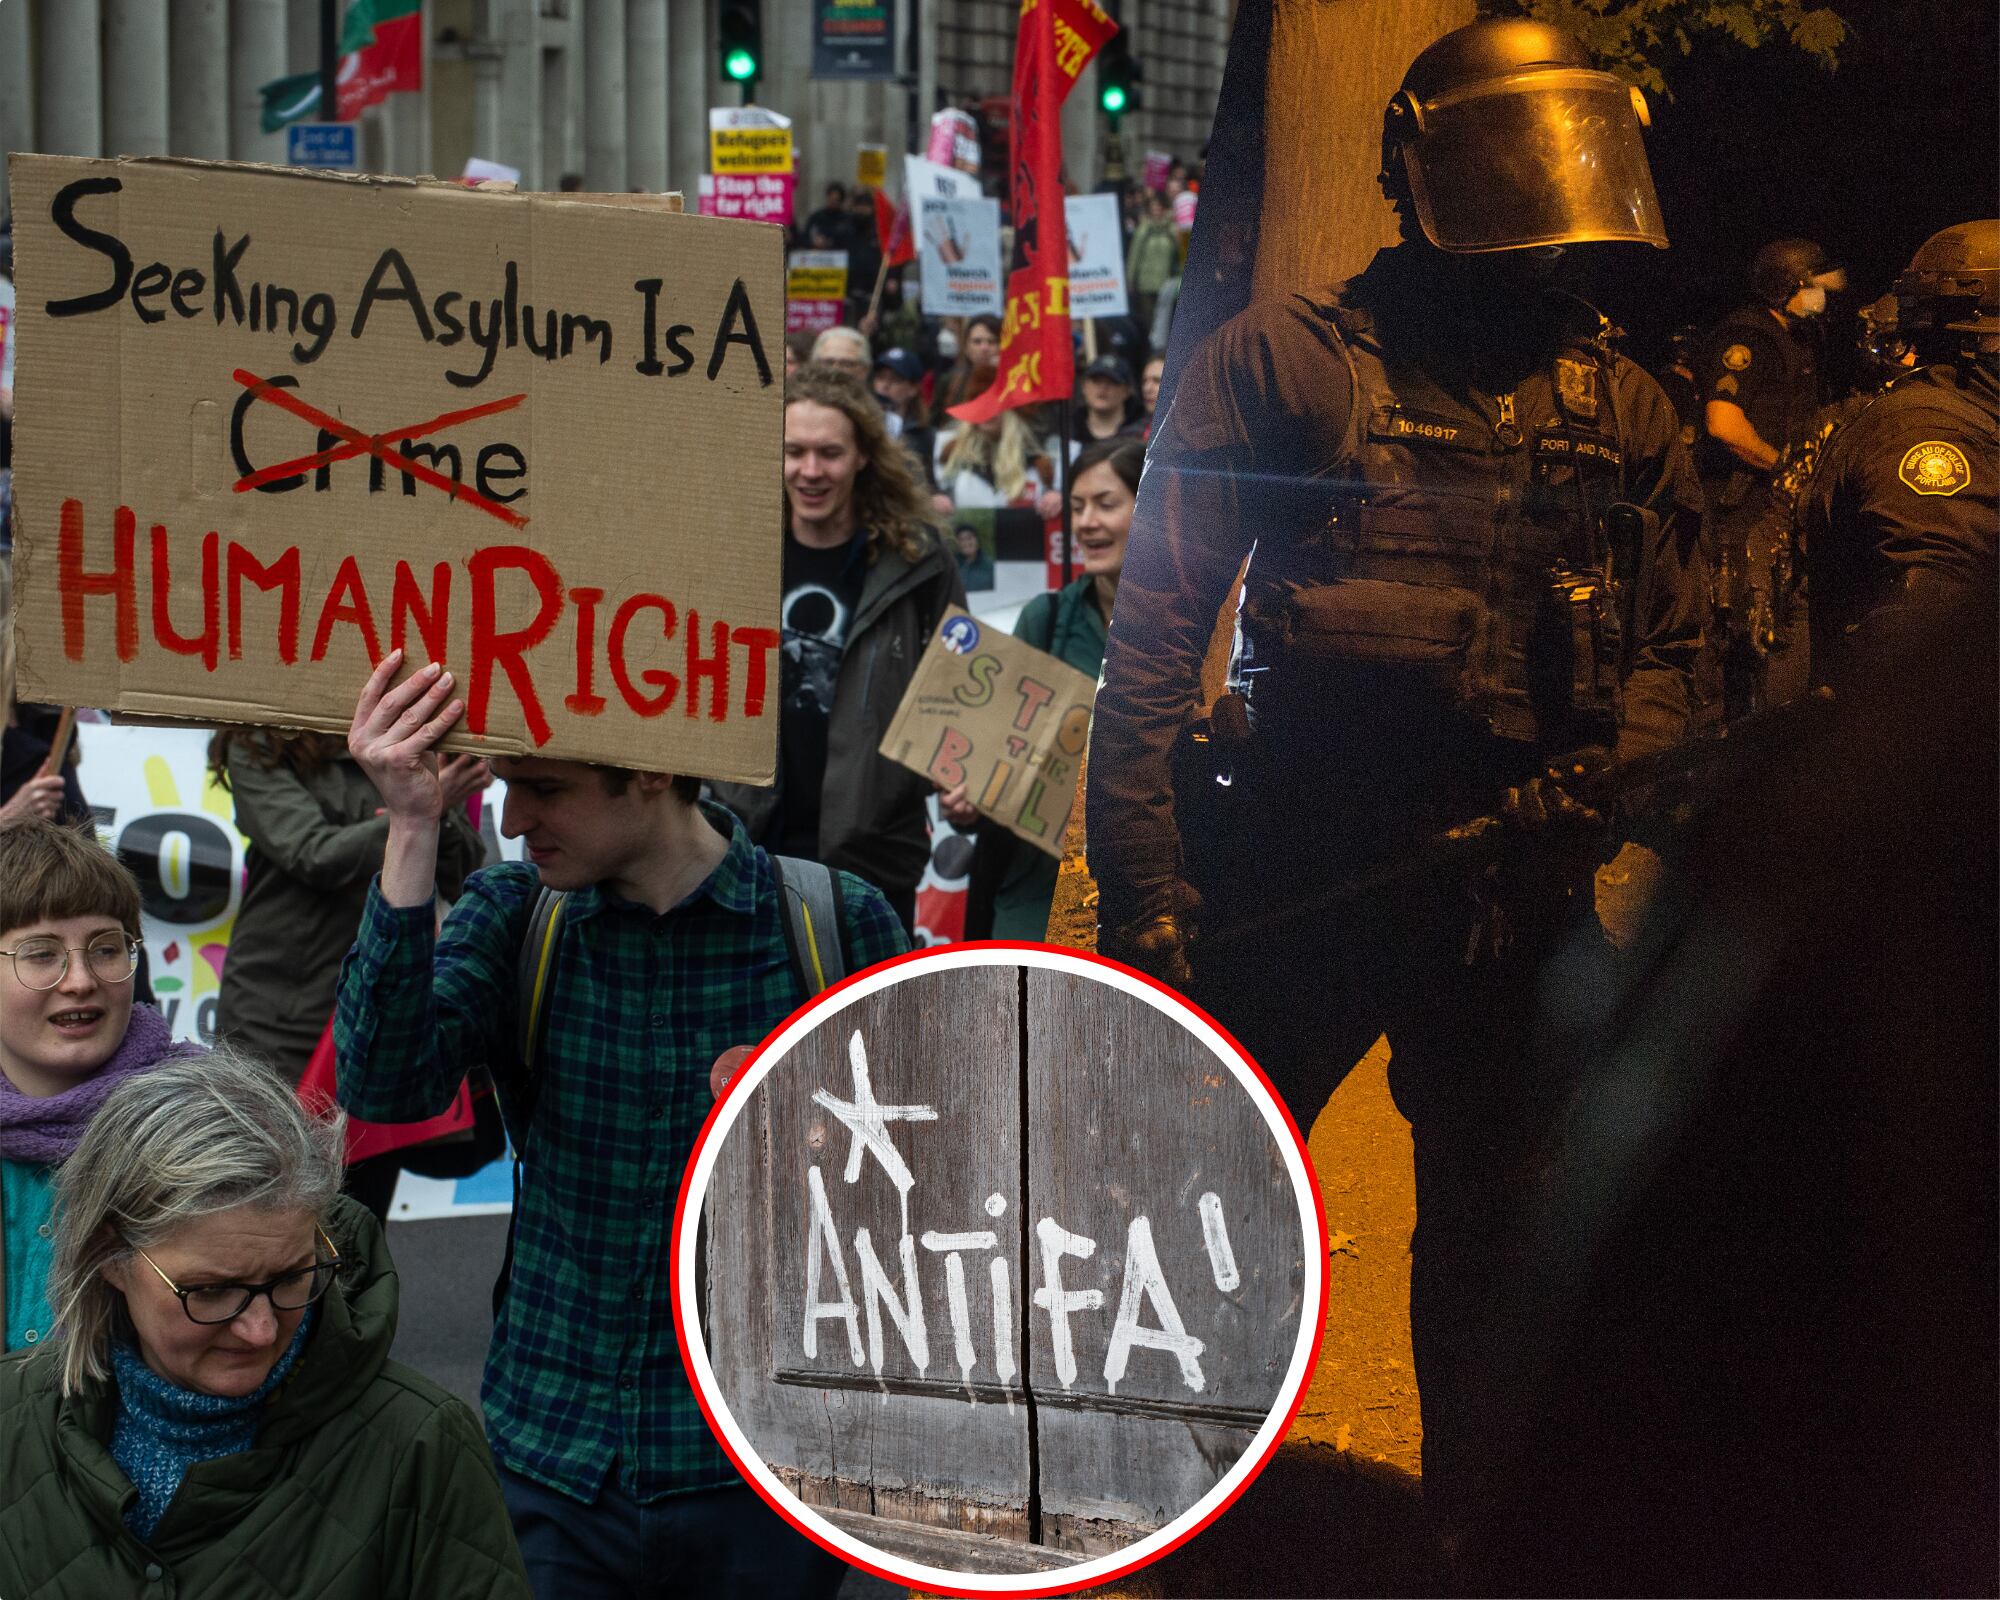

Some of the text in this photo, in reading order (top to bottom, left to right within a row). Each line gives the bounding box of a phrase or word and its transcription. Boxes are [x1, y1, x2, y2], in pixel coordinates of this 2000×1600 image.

[717, 131, 788, 149] Refugees
[717, 153, 784, 166] welcome
[717, 175, 784, 198] Stop the
[716, 195, 740, 214] far
[743, 195, 784, 217] right
[350, 248, 612, 388] Asylum
[634, 278, 695, 377] Is
[706, 276, 774, 388] A
[1398, 419, 1458, 442] 1046917
[1906, 446, 1933, 470] BUREAU
[1934, 446, 1946, 455] OF
[1944, 449, 1965, 475] POLICE
[1914, 474, 1957, 487] PORTLAND
[57, 497, 780, 748] HUMAN RIGHT
